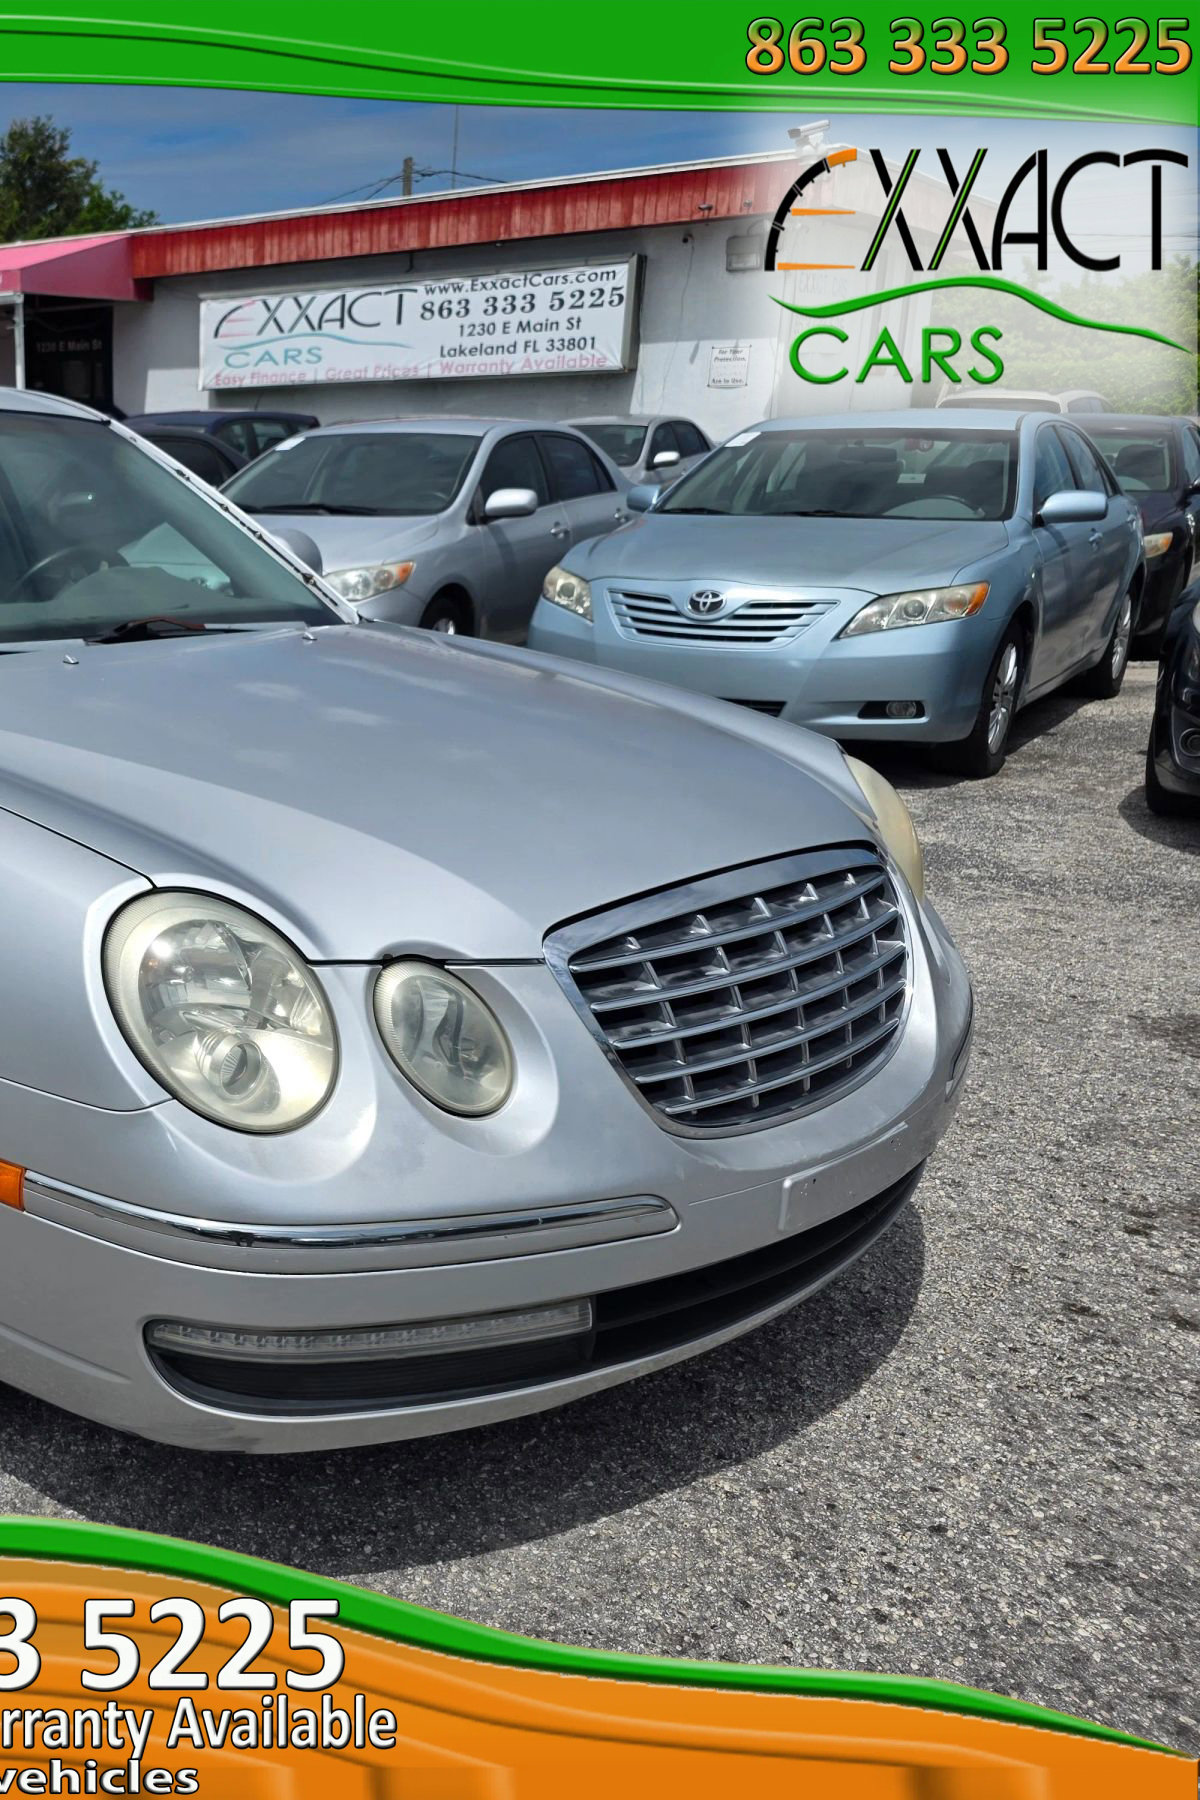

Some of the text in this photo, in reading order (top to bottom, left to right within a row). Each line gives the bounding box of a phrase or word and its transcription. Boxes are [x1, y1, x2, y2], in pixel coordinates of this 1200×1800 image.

[424, 269, 617, 296] www.ExxactCars.com
[214, 288, 418, 338] EXXACT
[420, 286, 625, 321] 863 333 5225
[459, 316, 582, 337] 1230 E Main St
[224, 347, 322, 369] CARS
[440, 336, 596, 358] Lakeland FL 33801
[215, 353, 608, 388] Easy Finance Great Prices Warranty Available
